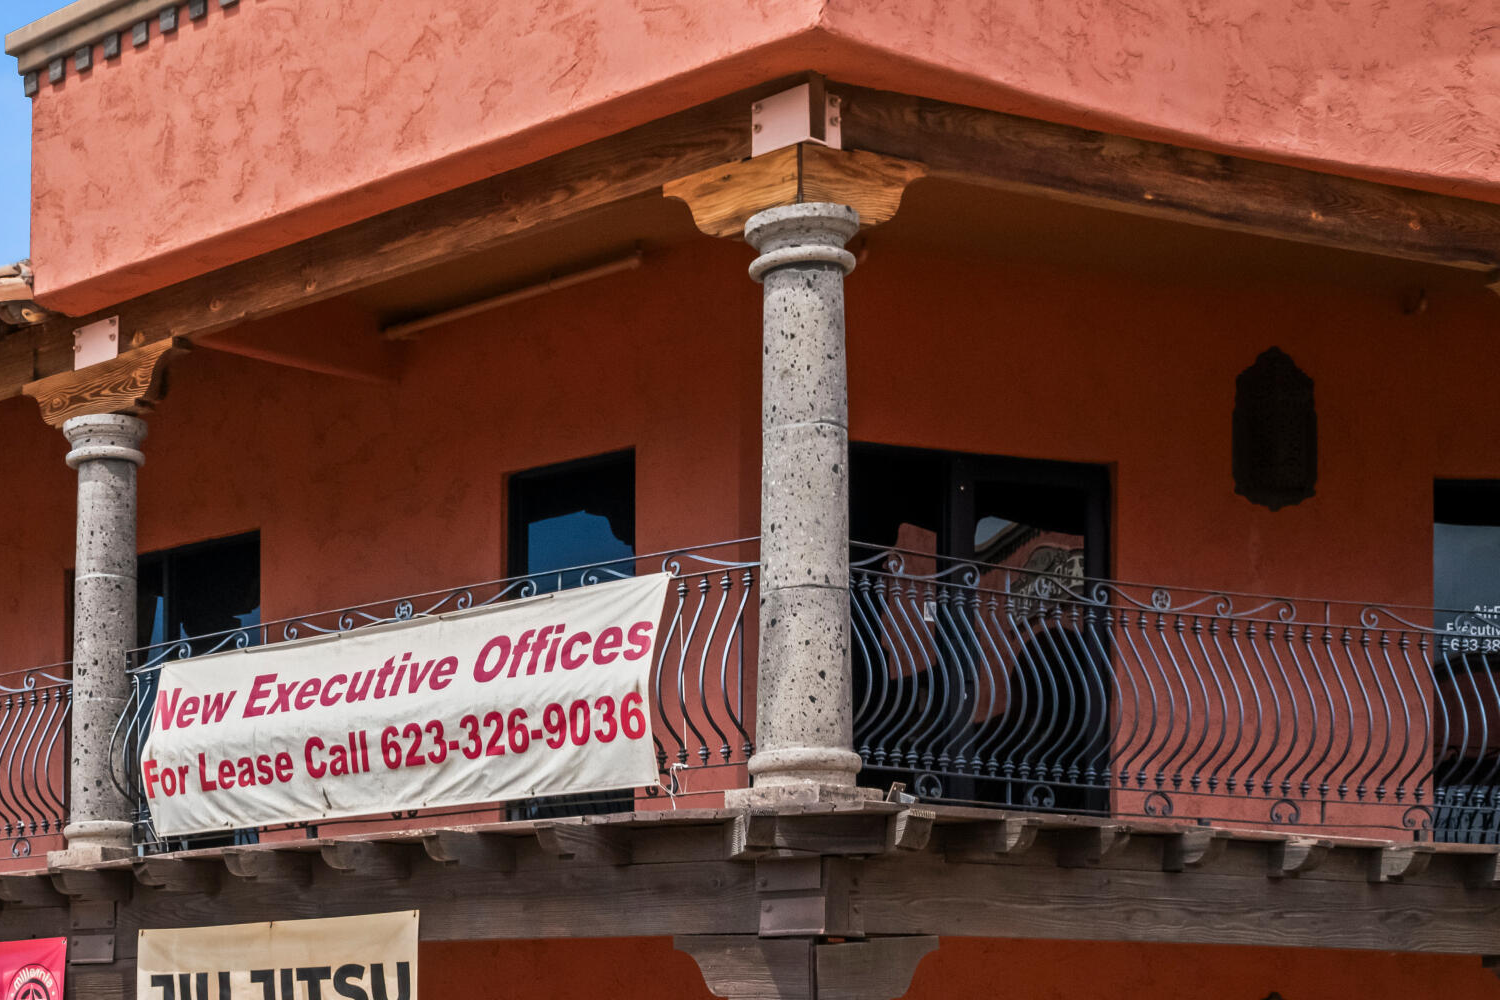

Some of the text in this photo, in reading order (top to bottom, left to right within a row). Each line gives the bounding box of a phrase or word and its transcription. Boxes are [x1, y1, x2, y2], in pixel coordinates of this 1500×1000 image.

[154, 620, 655, 731] New Executive Offices
[143, 692, 646, 799] For Lease Call 623-326-9036
